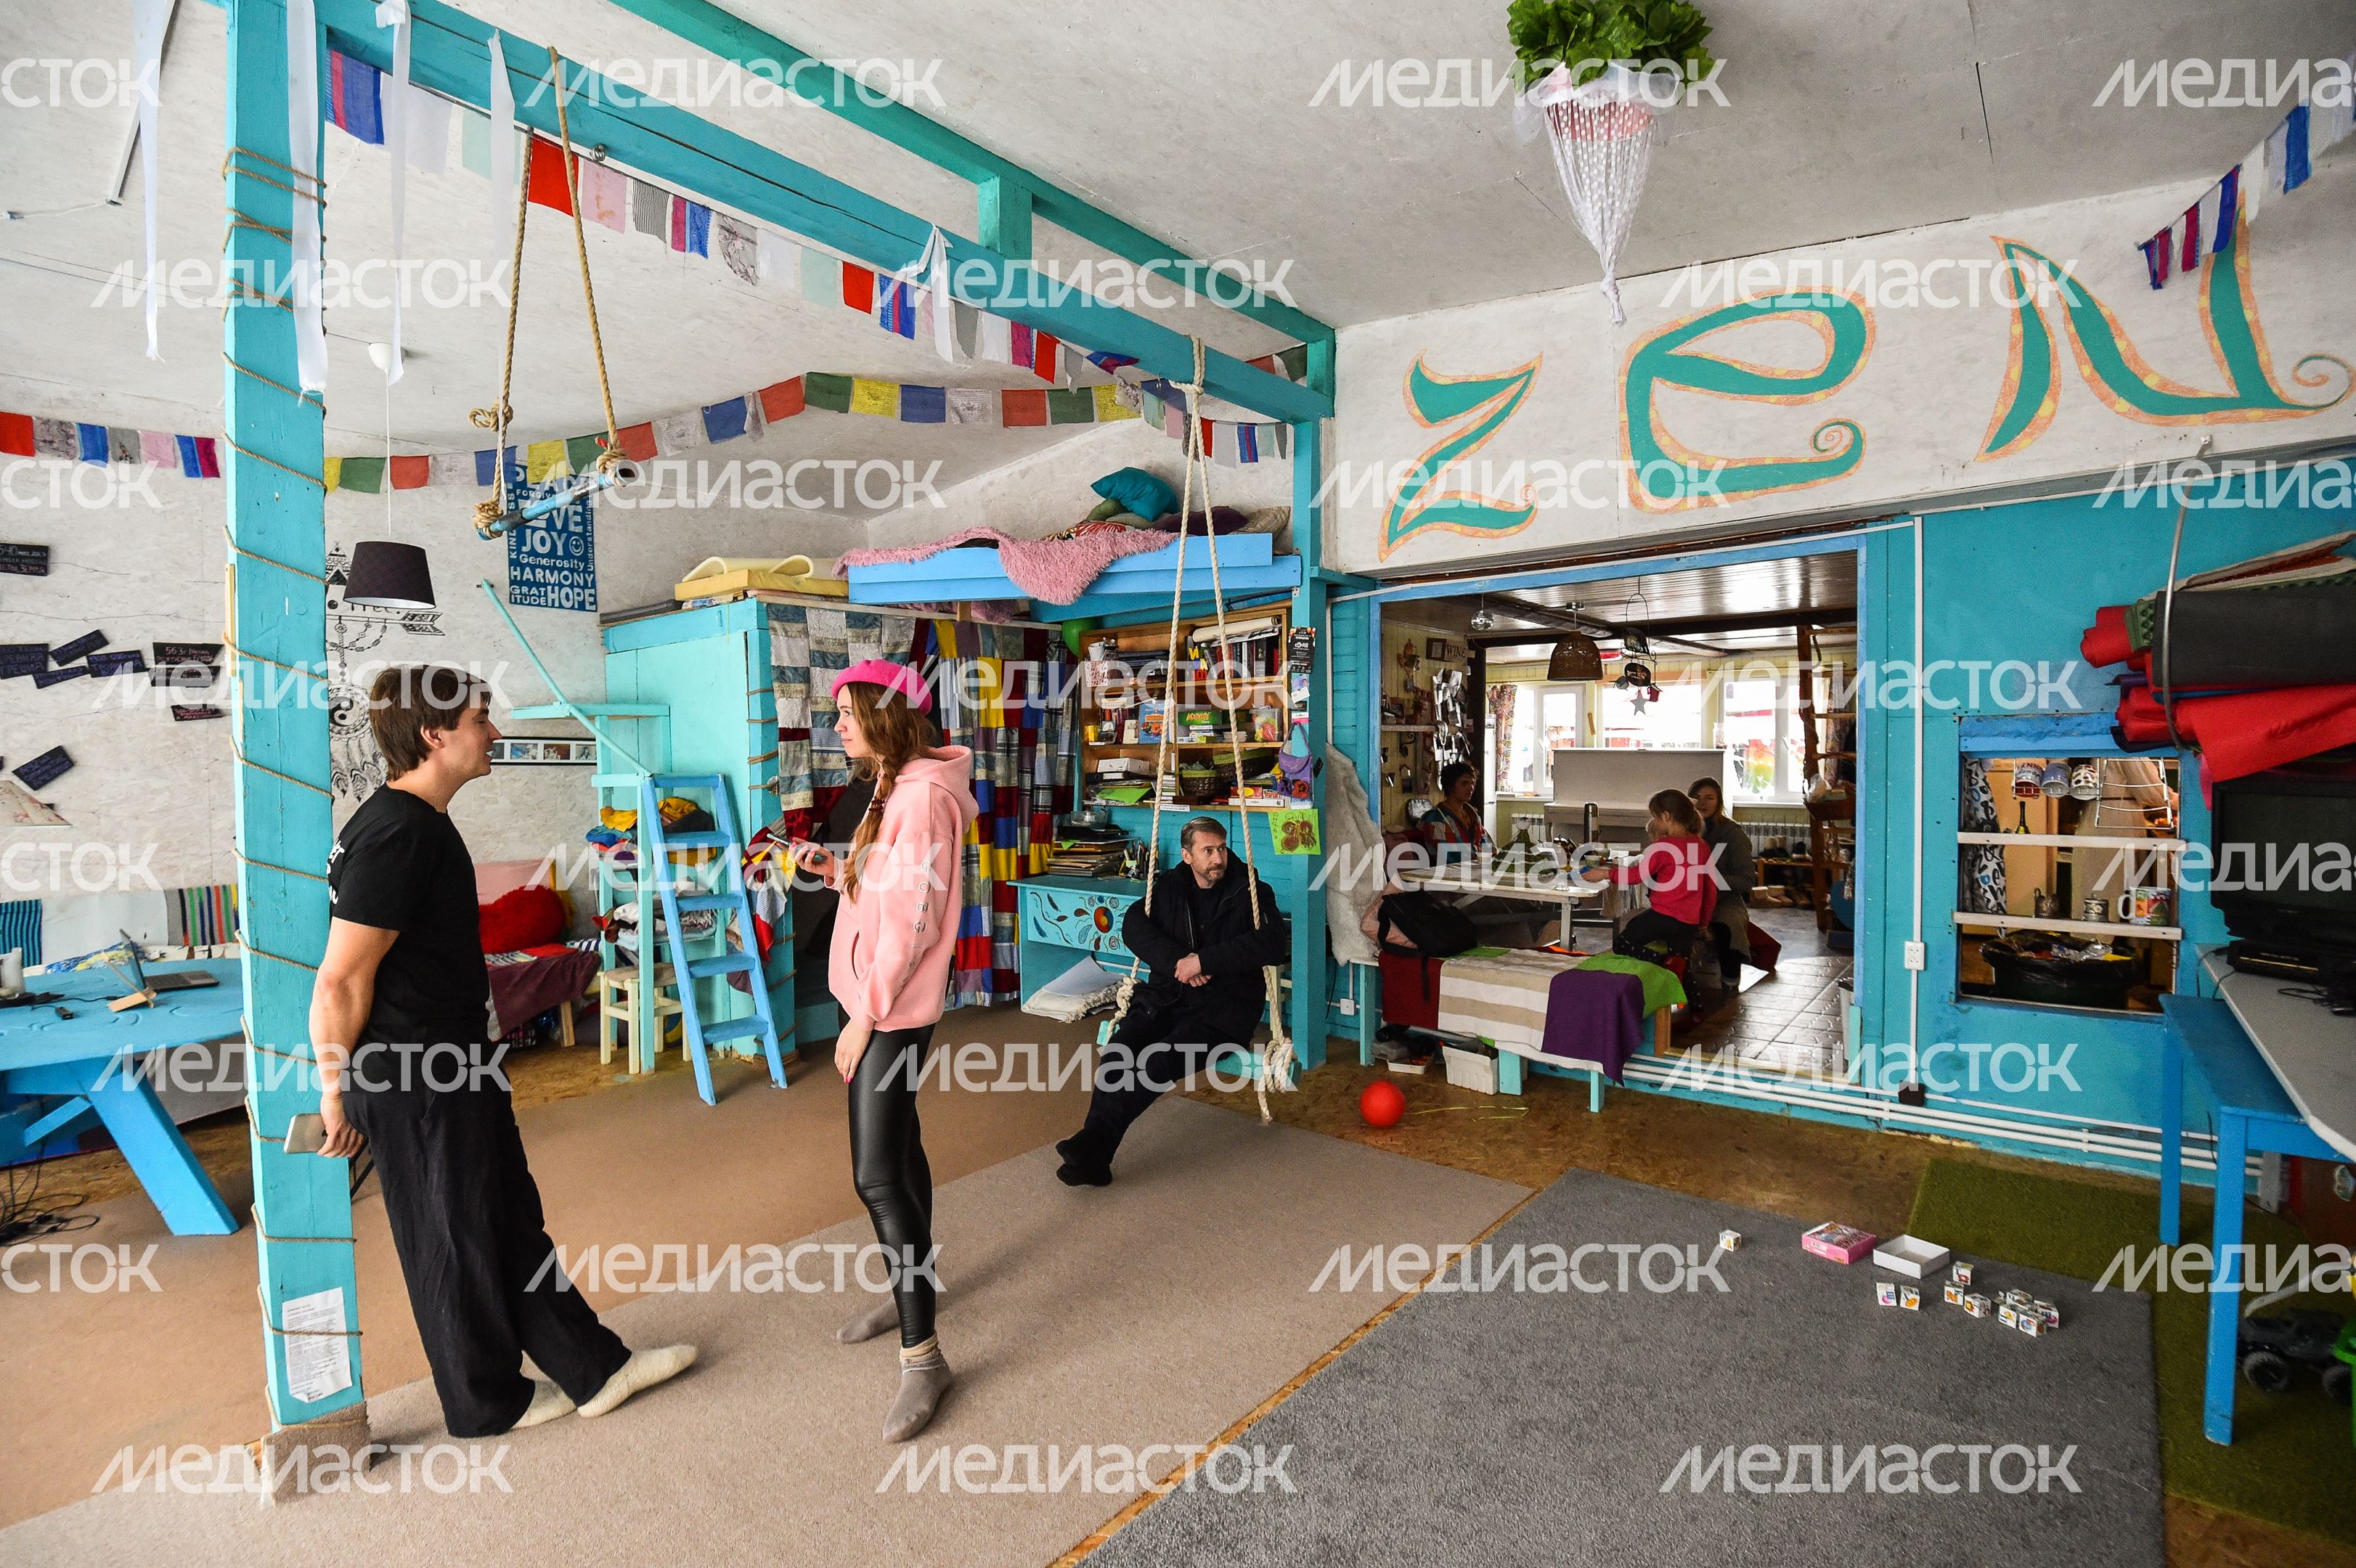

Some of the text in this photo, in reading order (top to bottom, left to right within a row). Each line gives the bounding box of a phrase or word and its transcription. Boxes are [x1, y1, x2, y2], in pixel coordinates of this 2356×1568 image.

[521, 529, 567, 556] JOY
[519, 554, 584, 571] Generosity
[510, 566, 594, 588] HARMONY
[547, 586, 596, 611] HOPE
[1447, 643, 1467, 658] WINE
